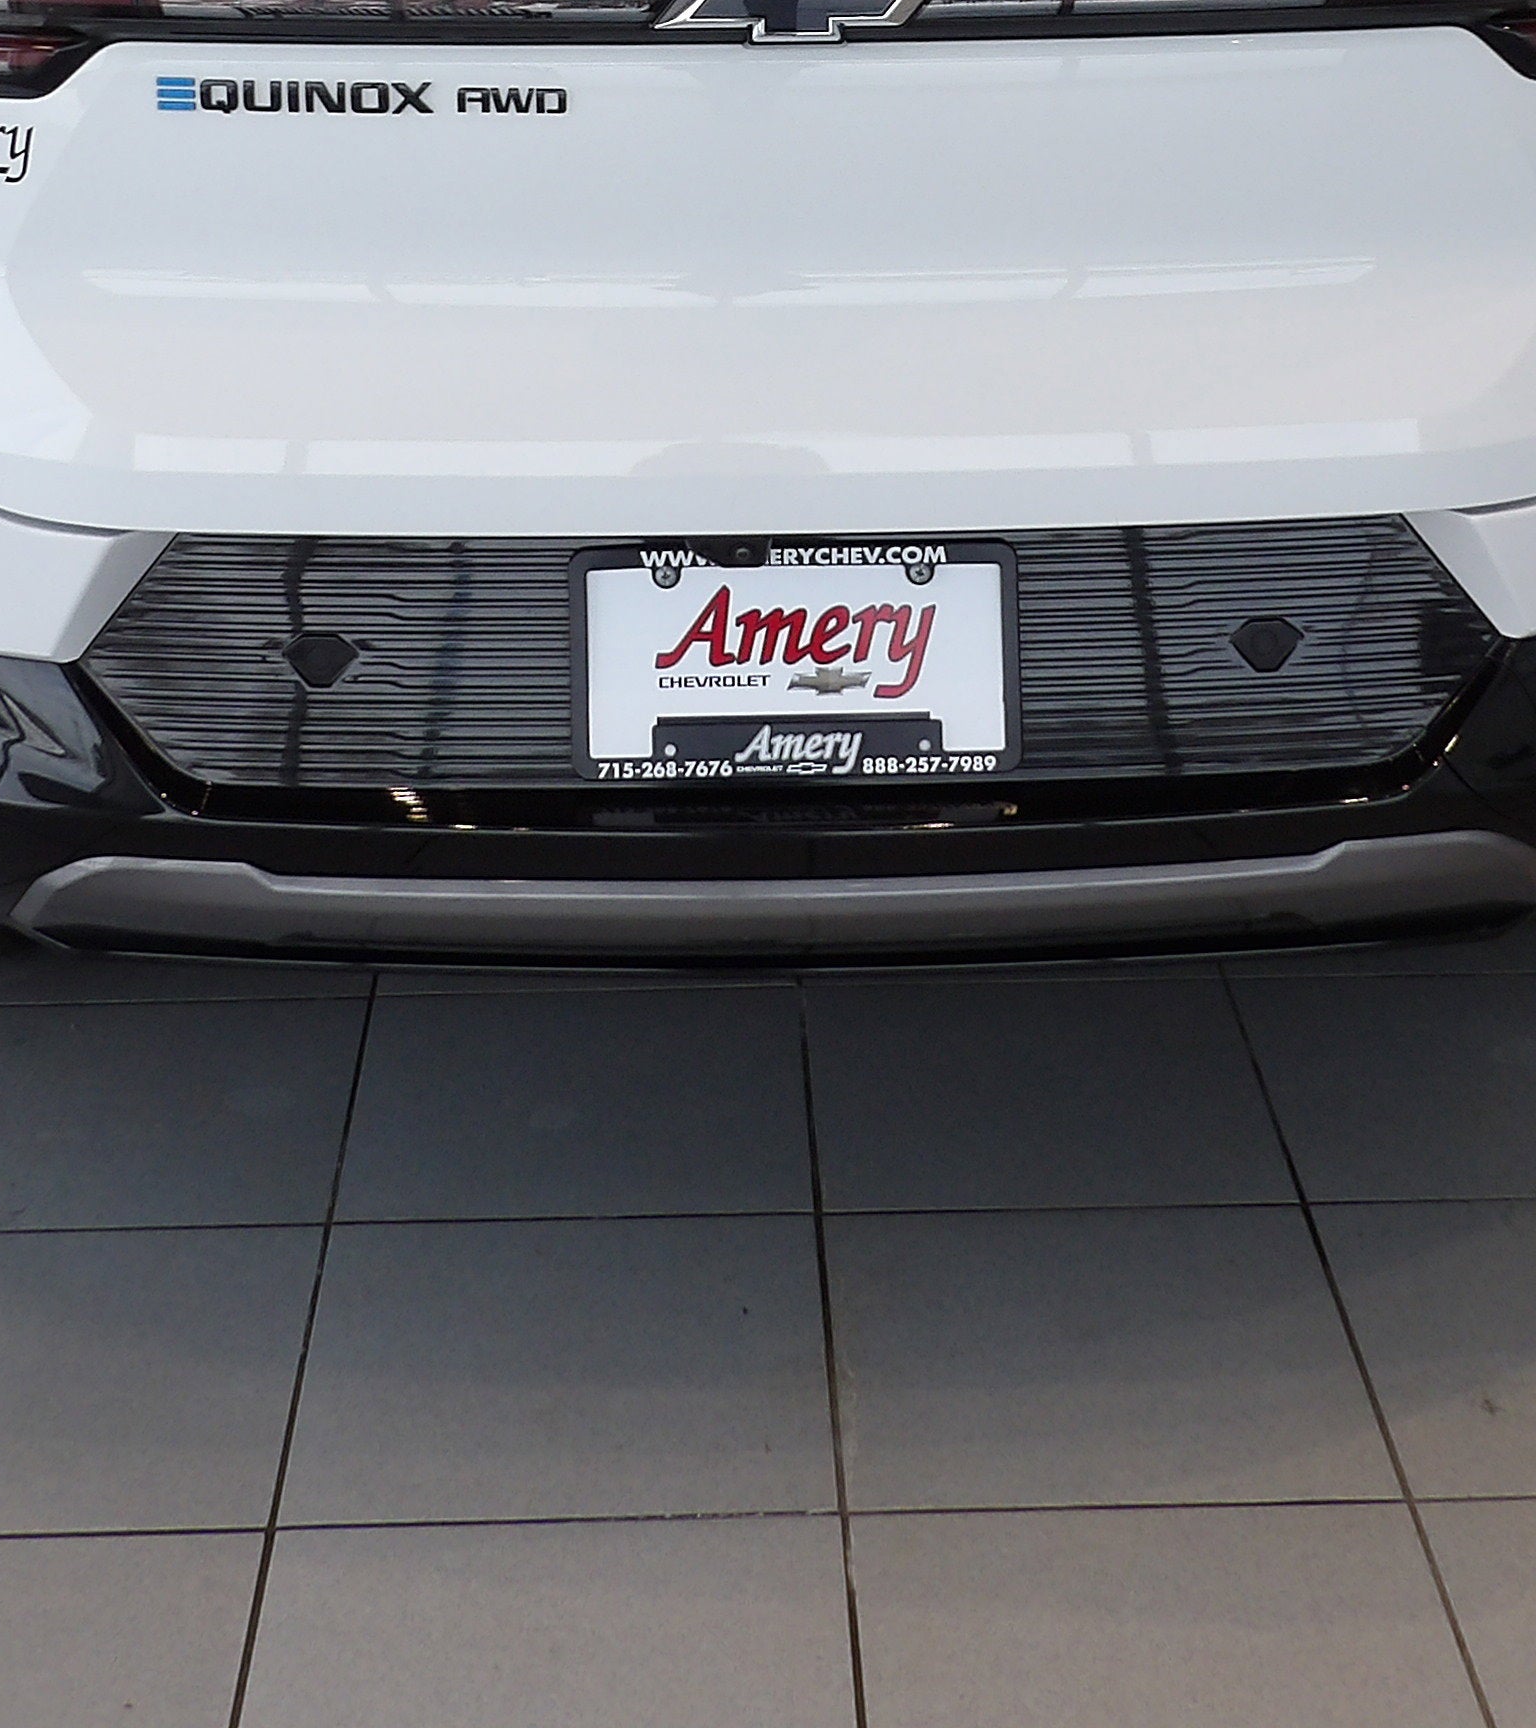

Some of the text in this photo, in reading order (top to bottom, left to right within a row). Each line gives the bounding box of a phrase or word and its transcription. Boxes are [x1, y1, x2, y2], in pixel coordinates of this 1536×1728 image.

[156, 76, 568, 115] EQUINOX AWD
[655, 585, 937, 699] Amery
[658, 674, 772, 689] CHEVROLET
[735, 724, 863, 775] Amery
[598, 760, 733, 779] 715-268-7676
[862, 755, 997, 774] 888-257-7989
